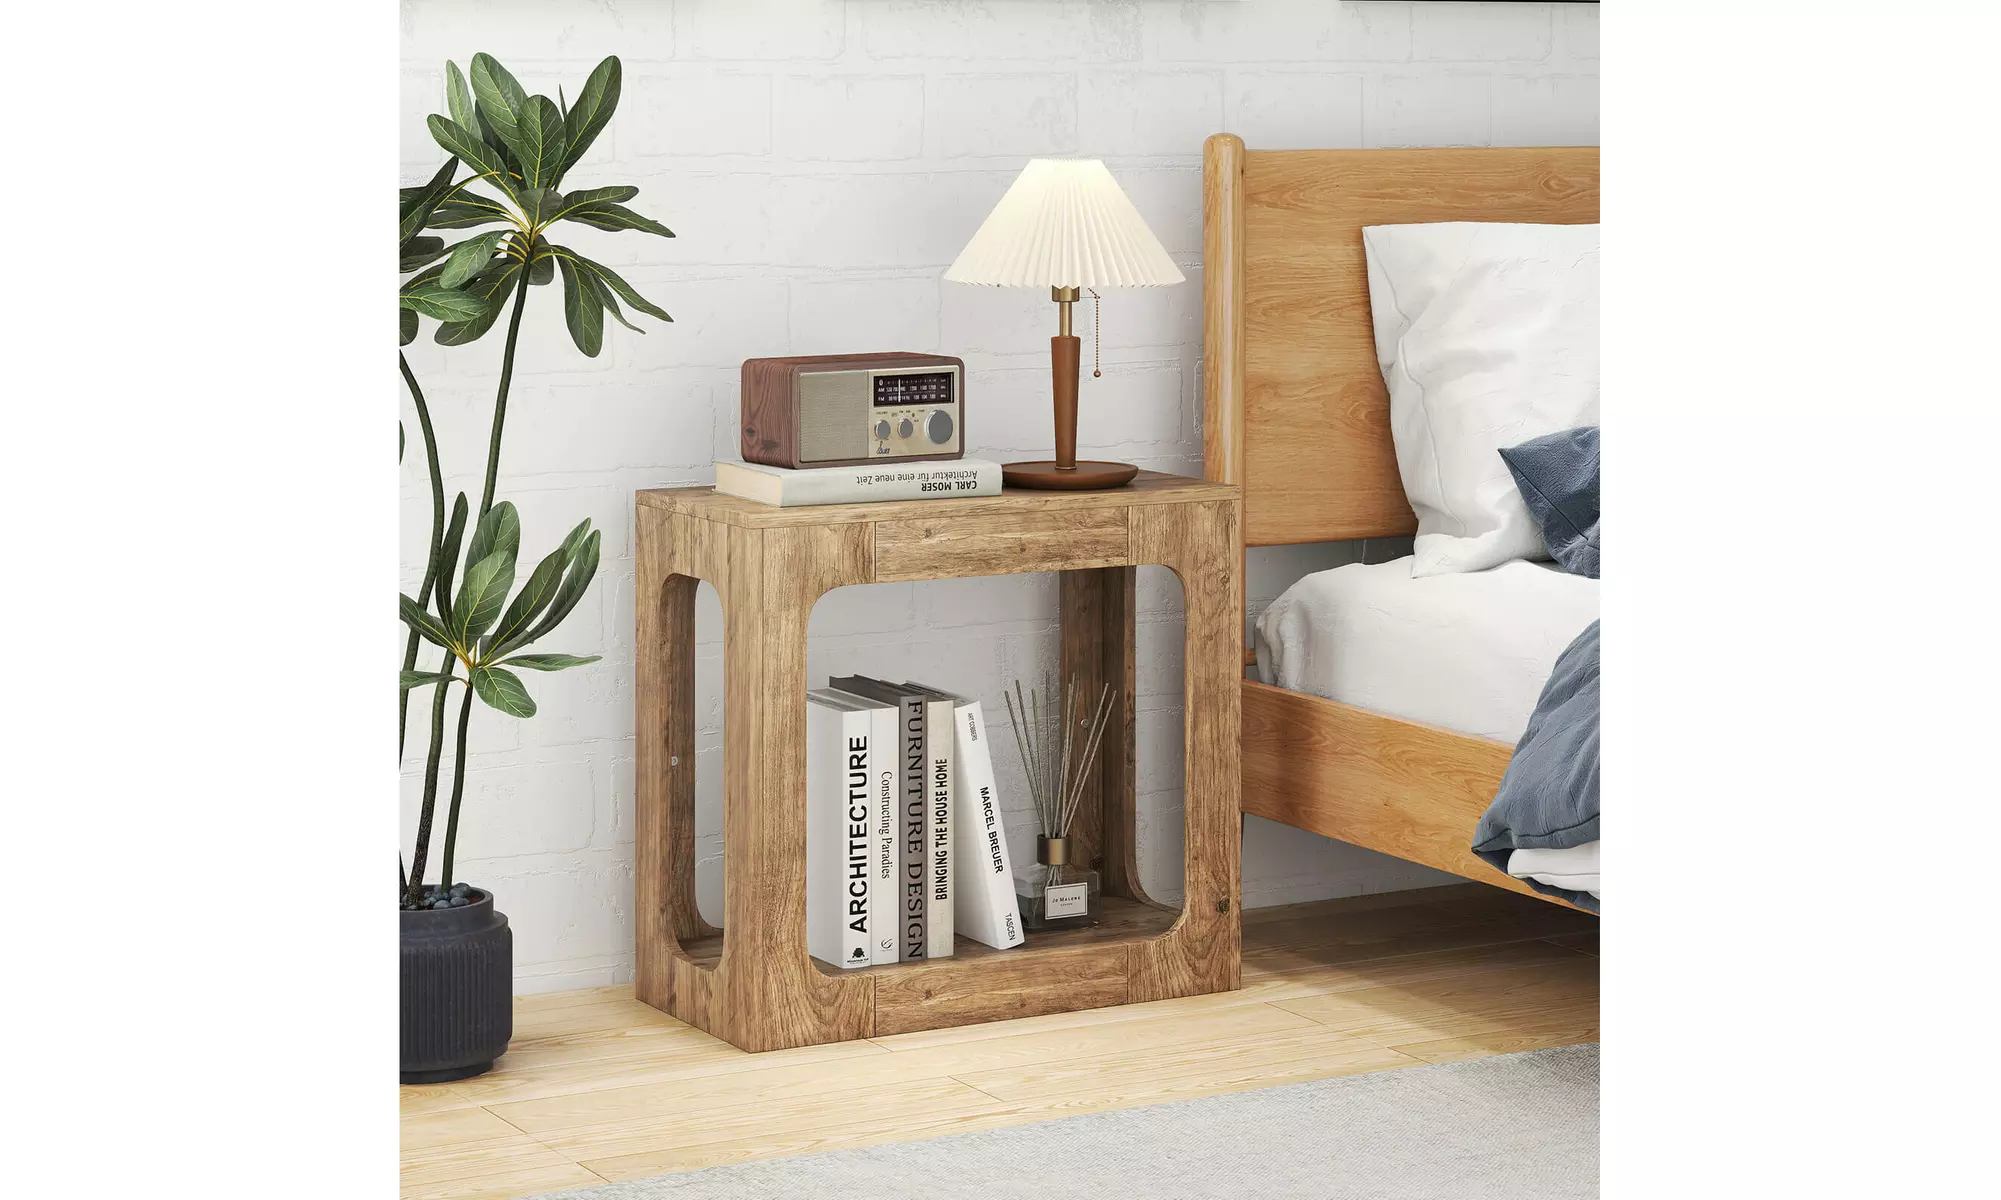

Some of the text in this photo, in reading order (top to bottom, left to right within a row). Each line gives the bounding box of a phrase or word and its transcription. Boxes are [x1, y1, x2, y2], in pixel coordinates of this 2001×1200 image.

[856, 470, 978, 486] Architektur für eine neue Zeit
[921, 480, 978, 492] CARL MOSER
[849, 735, 868, 933] ARCHITECTURE
[879, 771, 893, 879] Constructing Paradies
[907, 701, 923, 959] FURNITURE DESIGN
[935, 758, 948, 901] BRINGING THE HOUSE HOME
[980, 786, 1004, 874] MARCEL BREUER
[1004, 912, 1016, 941] TASCEN
